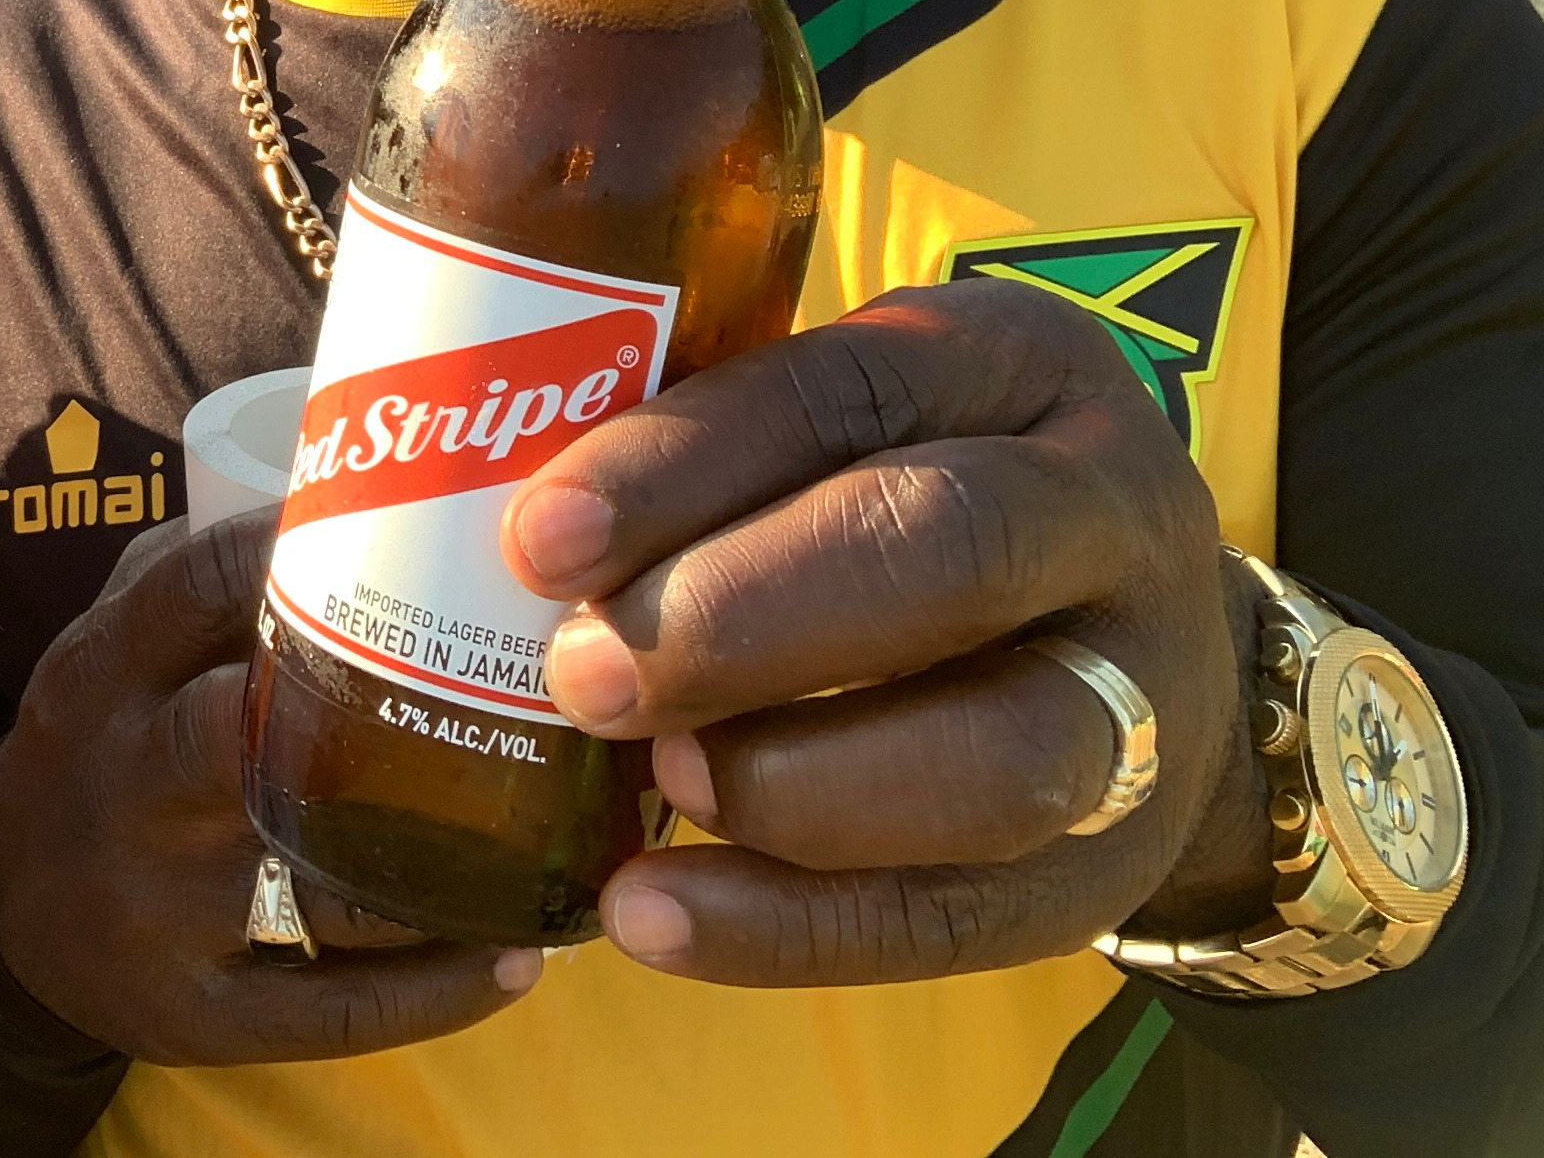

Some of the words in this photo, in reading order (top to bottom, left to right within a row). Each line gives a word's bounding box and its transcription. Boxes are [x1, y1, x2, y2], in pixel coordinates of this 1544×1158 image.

[323, 593, 417, 659] BREWED
[423, 637, 453, 672] IN
[354, 582, 434, 629] IMPORTED
[437, 615, 497, 648] LAGER
[378, 697, 431, 735] 4.7%
[433, 717, 547, 764] ALC./VOL.
